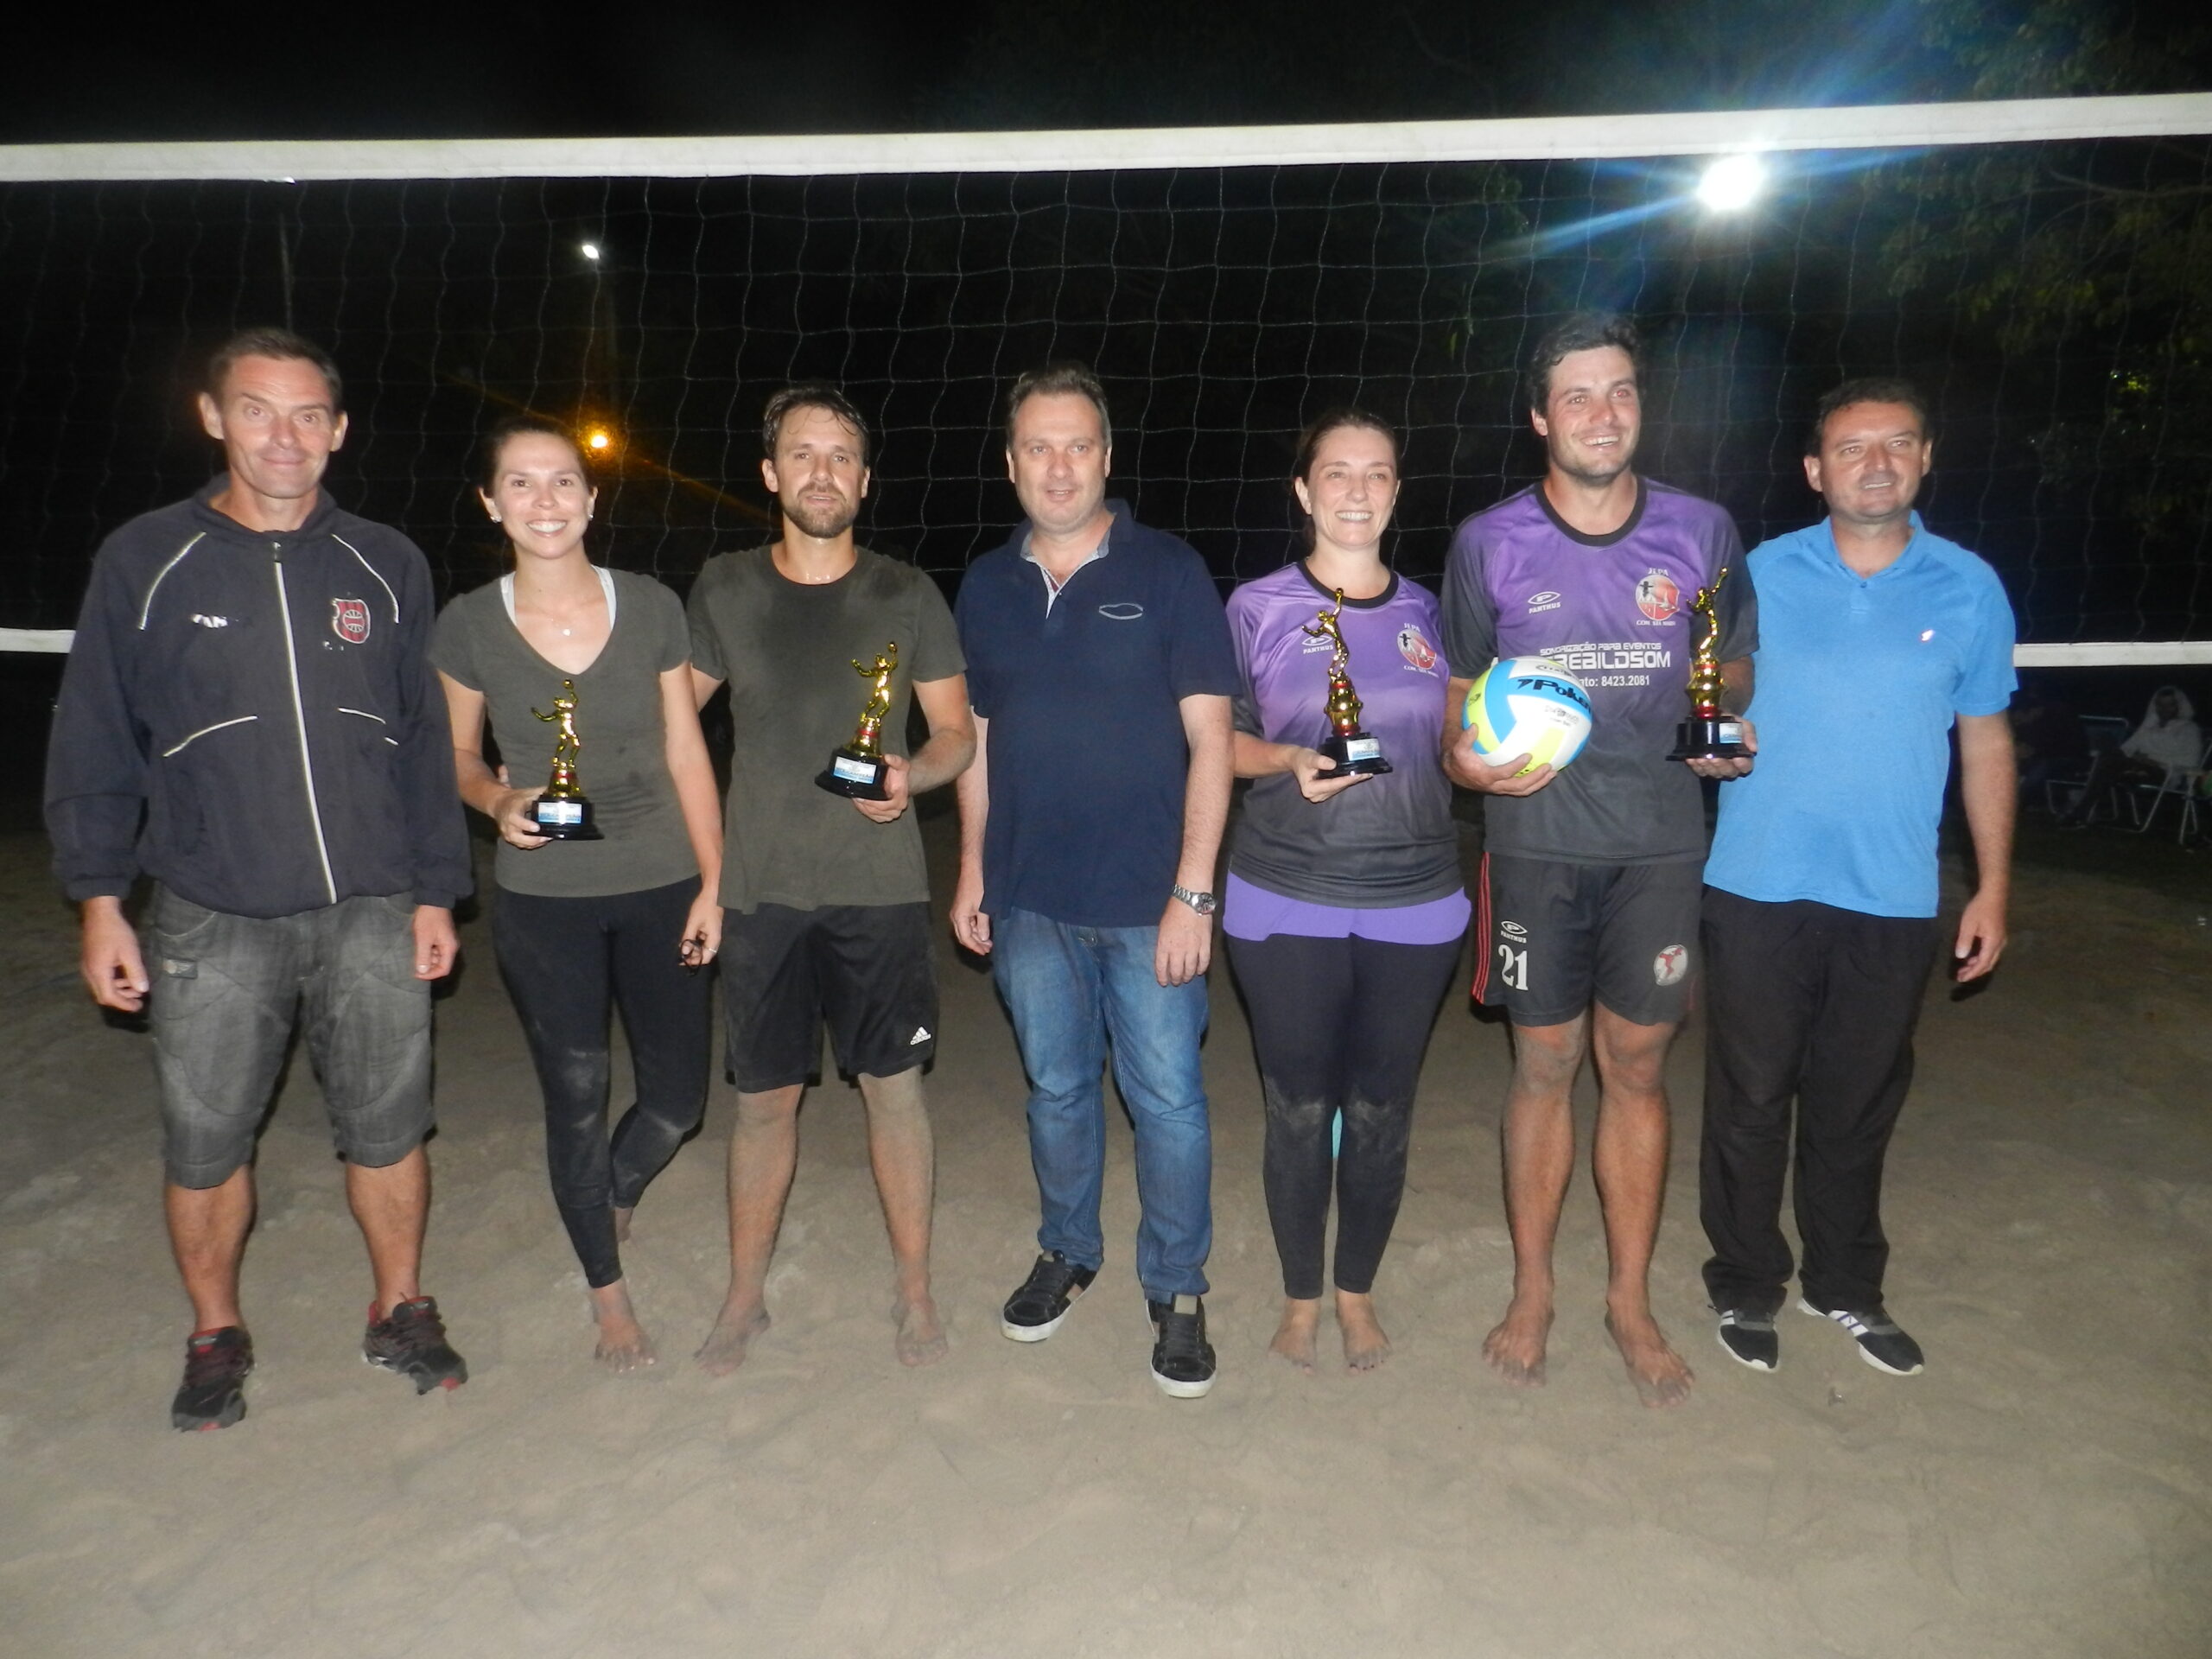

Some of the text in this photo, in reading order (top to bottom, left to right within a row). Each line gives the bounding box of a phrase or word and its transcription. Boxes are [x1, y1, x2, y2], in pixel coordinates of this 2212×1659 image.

[1623, 642, 1662, 651] EVENTOS
[1601, 675, 1650, 687] 8423.2081
[1497, 944, 1529, 991] 21
